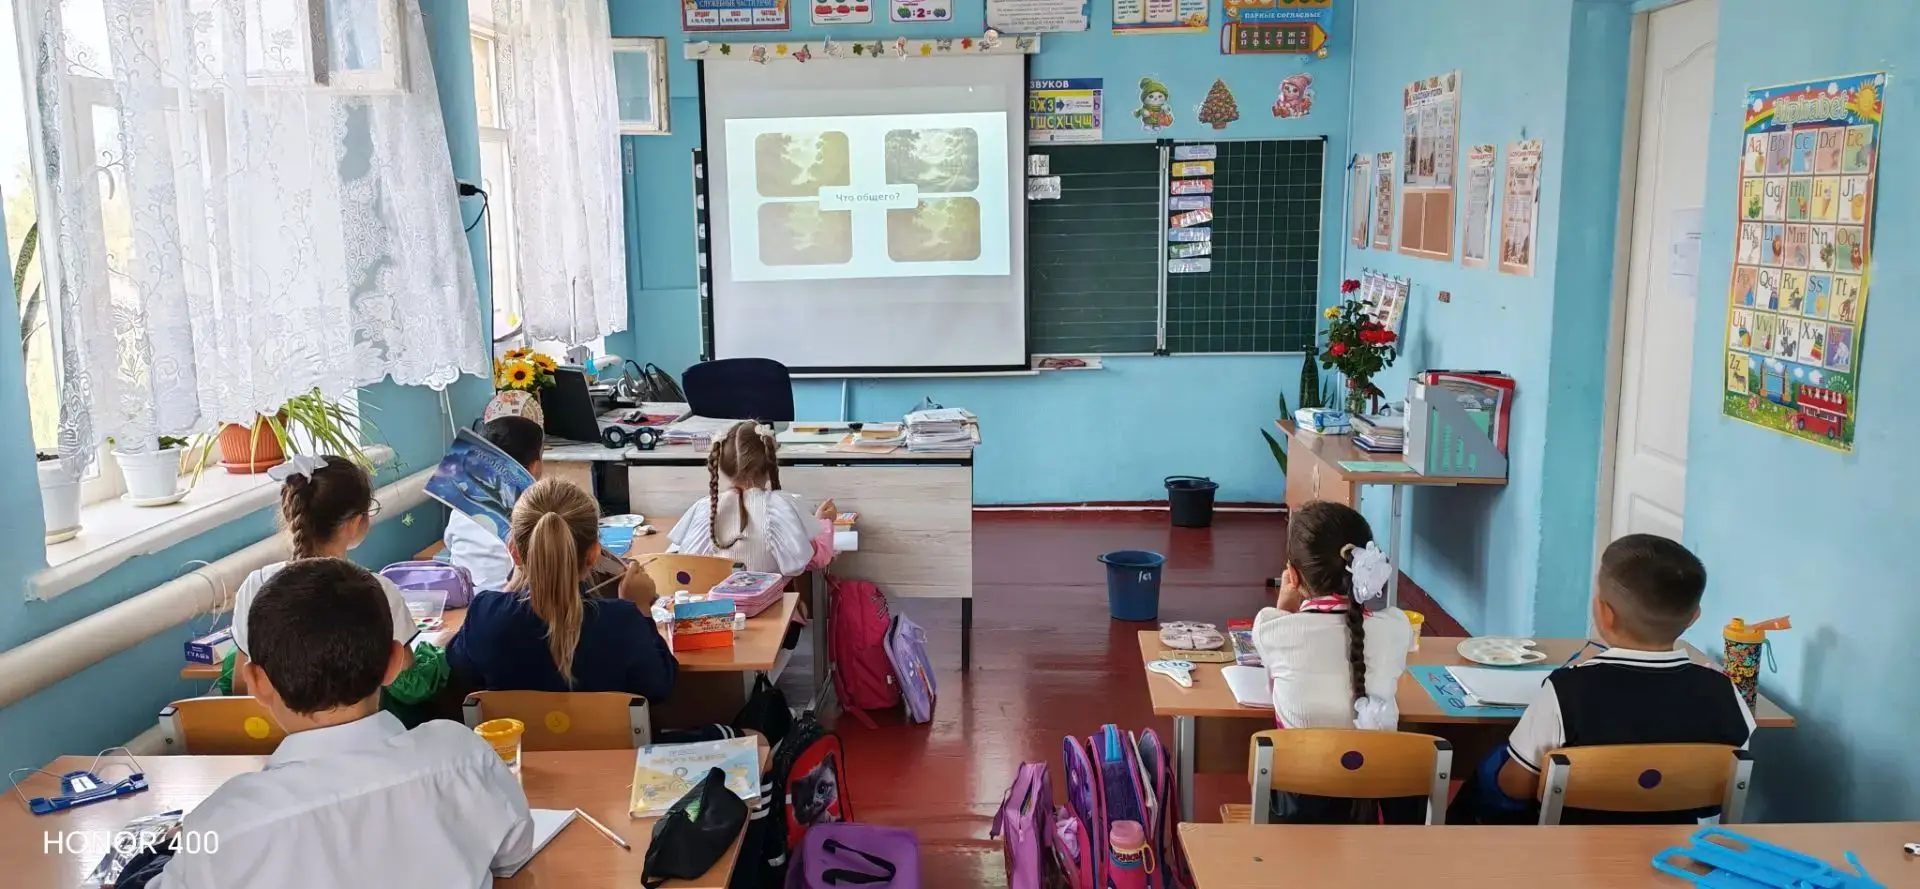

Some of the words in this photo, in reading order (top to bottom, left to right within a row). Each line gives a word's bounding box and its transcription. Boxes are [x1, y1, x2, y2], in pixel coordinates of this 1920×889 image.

[917, 8, 925, 18] 2
[1030, 80, 1070, 89] ЗВУКОВ
[1772, 91, 1849, 125] Alphabet
[1749, 138, 1762, 153] Aa
[1770, 135, 1785, 151] Bb
[1794, 133, 1810, 149] Cc
[1819, 131, 1836, 149] Dd
[1846, 129, 1863, 147] Ee
[836, 193, 854, 202] Что
[857, 192, 900, 202] общего?
[1744, 180, 1754, 197] Ff
[1765, 181, 1781, 202] Gg
[1814, 179, 1823, 197] Ii
[1842, 178, 1855, 201] Jj
[1743, 226, 1755, 241] Kk
[1764, 225, 1774, 241] Ll
[1787, 226, 1806, 243] Mm
[1811, 227, 1828, 245] Nn
[1837, 227, 1856, 245] Oo
[1759, 270, 1773, 290] Qq
[1783, 272, 1796, 289] Rr
[1808, 275, 1823, 292] Ss
[1835, 278, 1848, 296] Tt
[1732, 311, 1746, 328] Uu
[1756, 314, 1768, 331] Vv
[1778, 318, 1792, 336] Ww
[1803, 322, 1818, 340] Xx
[1729, 353, 1740, 371] Zz
[187, 650, 210, 660] ГУАШЬ
